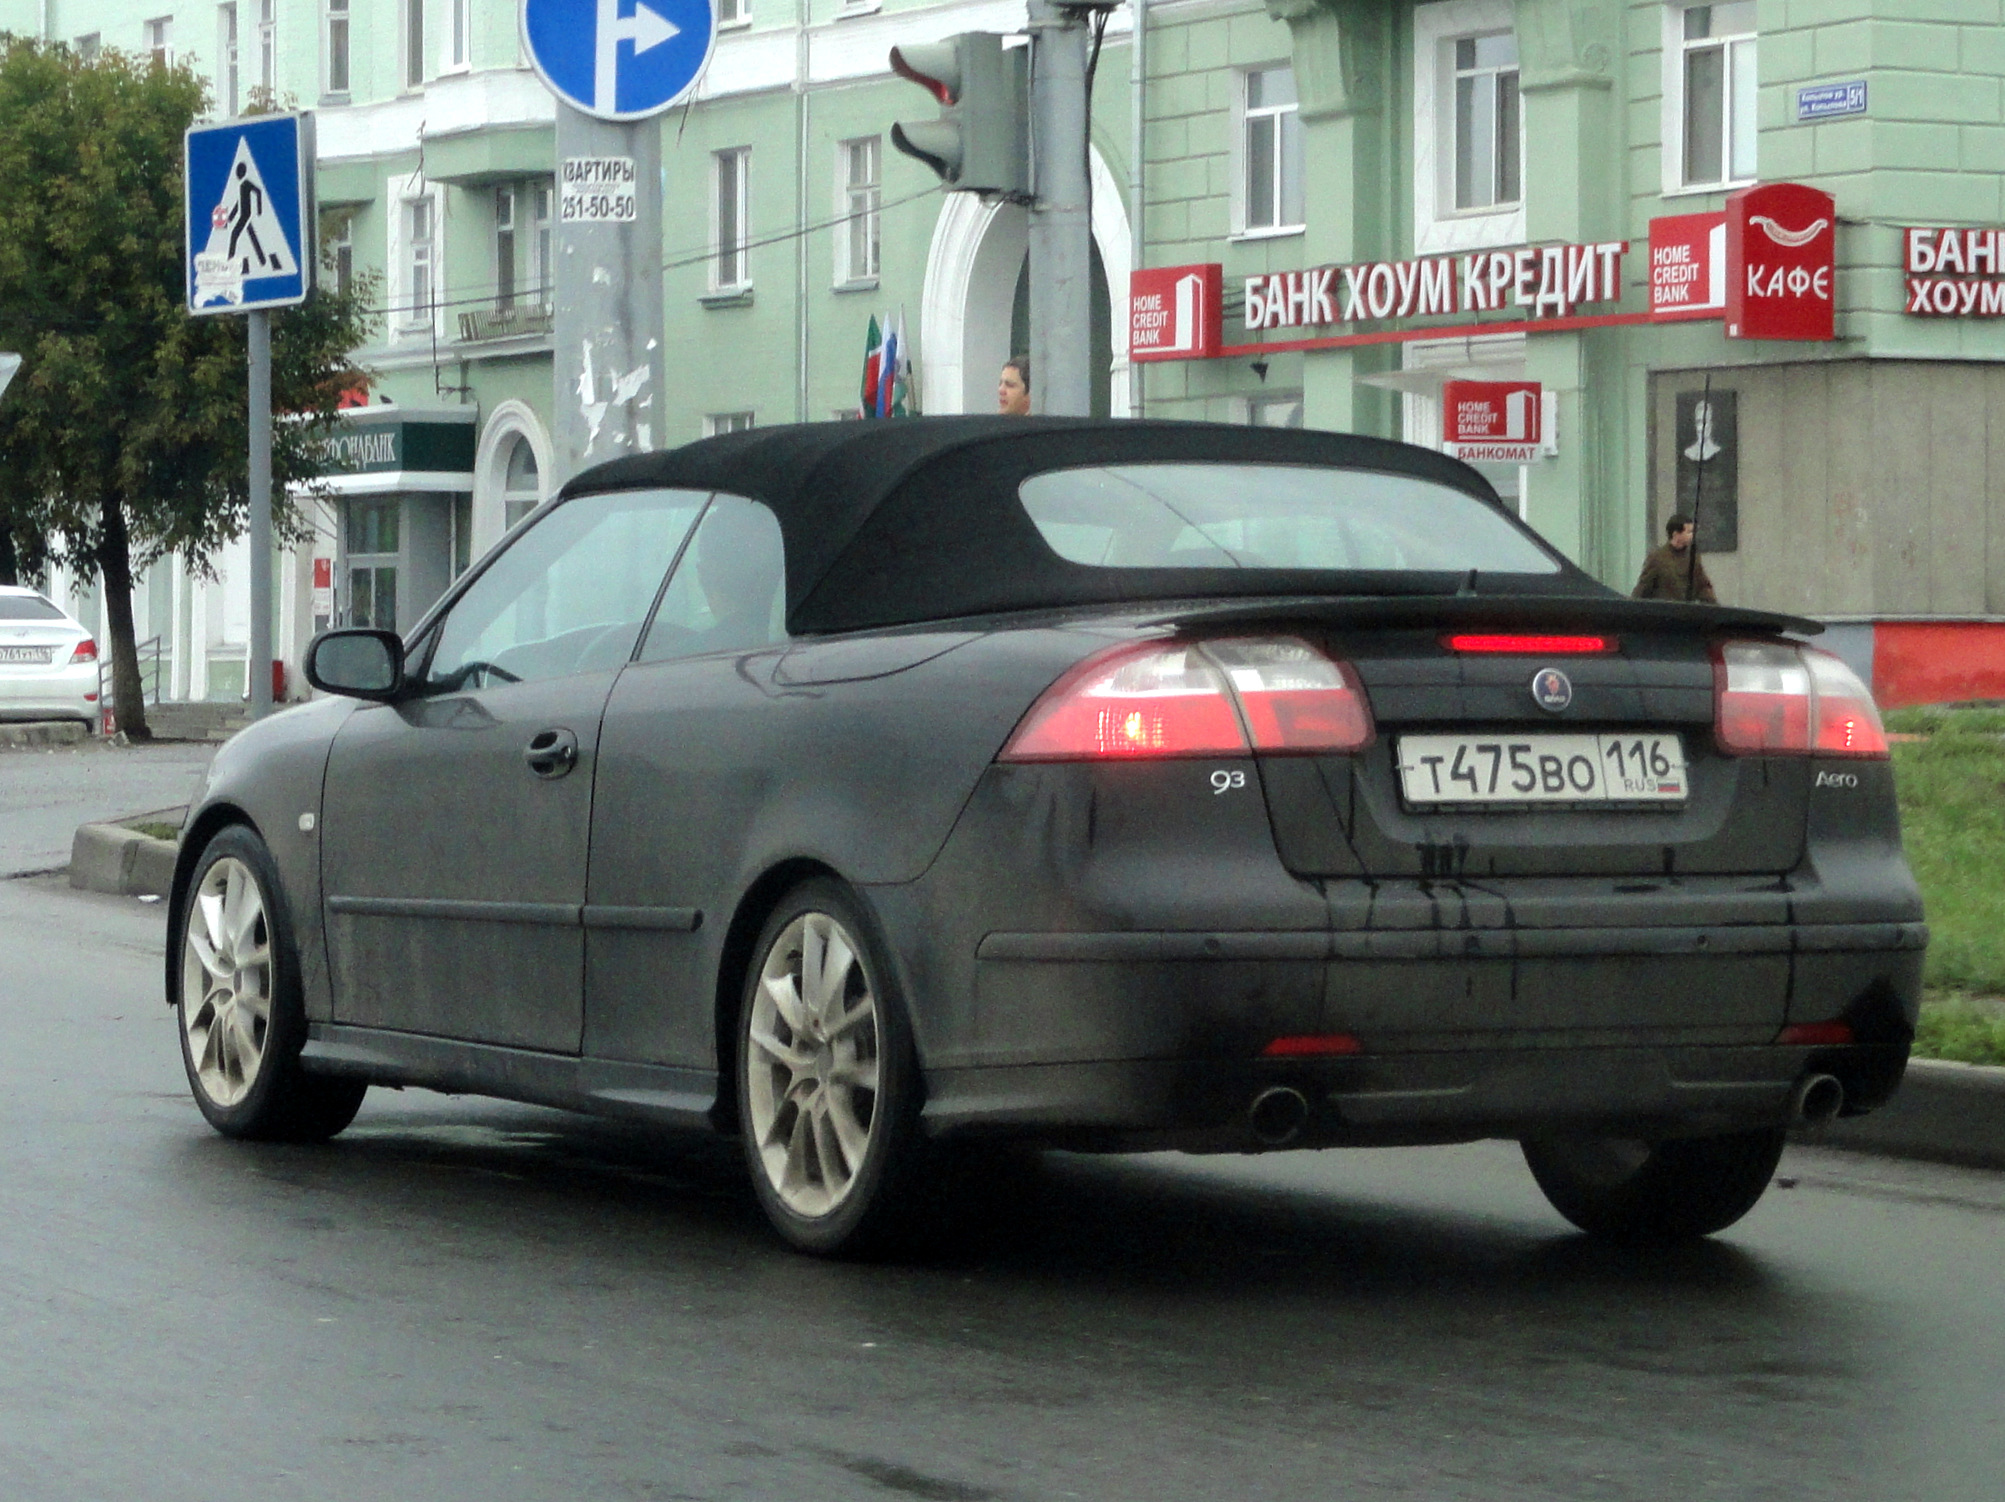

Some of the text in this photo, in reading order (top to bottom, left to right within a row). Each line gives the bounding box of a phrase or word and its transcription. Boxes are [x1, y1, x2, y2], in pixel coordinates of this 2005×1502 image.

[562, 195, 634, 218] 251-50-50
[1654, 245, 1690, 265] HOME
[1653, 263, 1699, 285] CREDIT
[1747, 264, 1828, 299] КАФЕ
[1245, 242, 1622, 330] БАНК ХОУМ КРЕДИТ
[1654, 283, 1689, 304] BANK
[1133, 293, 1161, 312] HOME
[1907, 279, 2005, 315] ХОУМ
[1132, 310, 1169, 329] CREDIT
[1132, 329, 1160, 346] BANK
[1457, 401, 1491, 413] HOME
[1457, 412, 1498, 425] CREDIT
[1457, 423, 1490, 435] BANK
[1457, 446, 1537, 460] БАНКОМАТ
[1605, 740, 1670, 778] 116
[1210, 770, 1246, 795] 93
[1623, 779, 1657, 792] RUS
[1815, 770, 1859, 788] Aero
